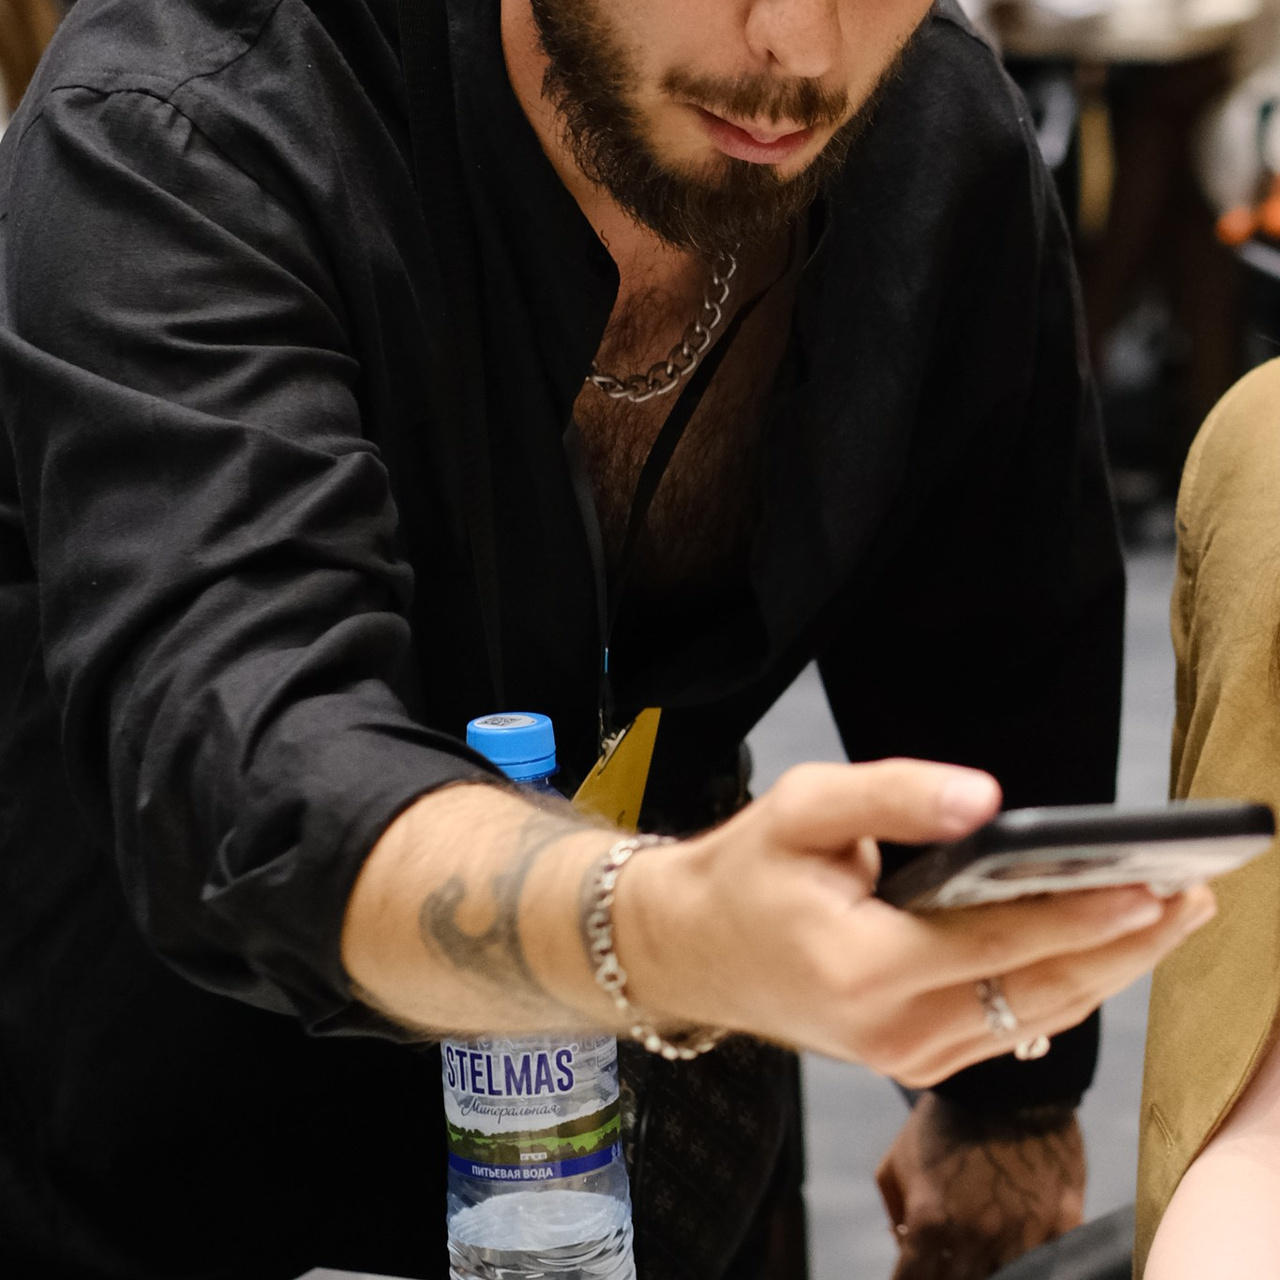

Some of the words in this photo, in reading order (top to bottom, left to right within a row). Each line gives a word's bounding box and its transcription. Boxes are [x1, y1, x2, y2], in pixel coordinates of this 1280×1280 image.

[446, 1045, 574, 1097] STELMAS
[461, 1098, 560, 1124] Минеральная
[472, 1165, 520, 1180] ПИТЬЕВАЯ
[522, 1167, 553, 1180] ВОДА
